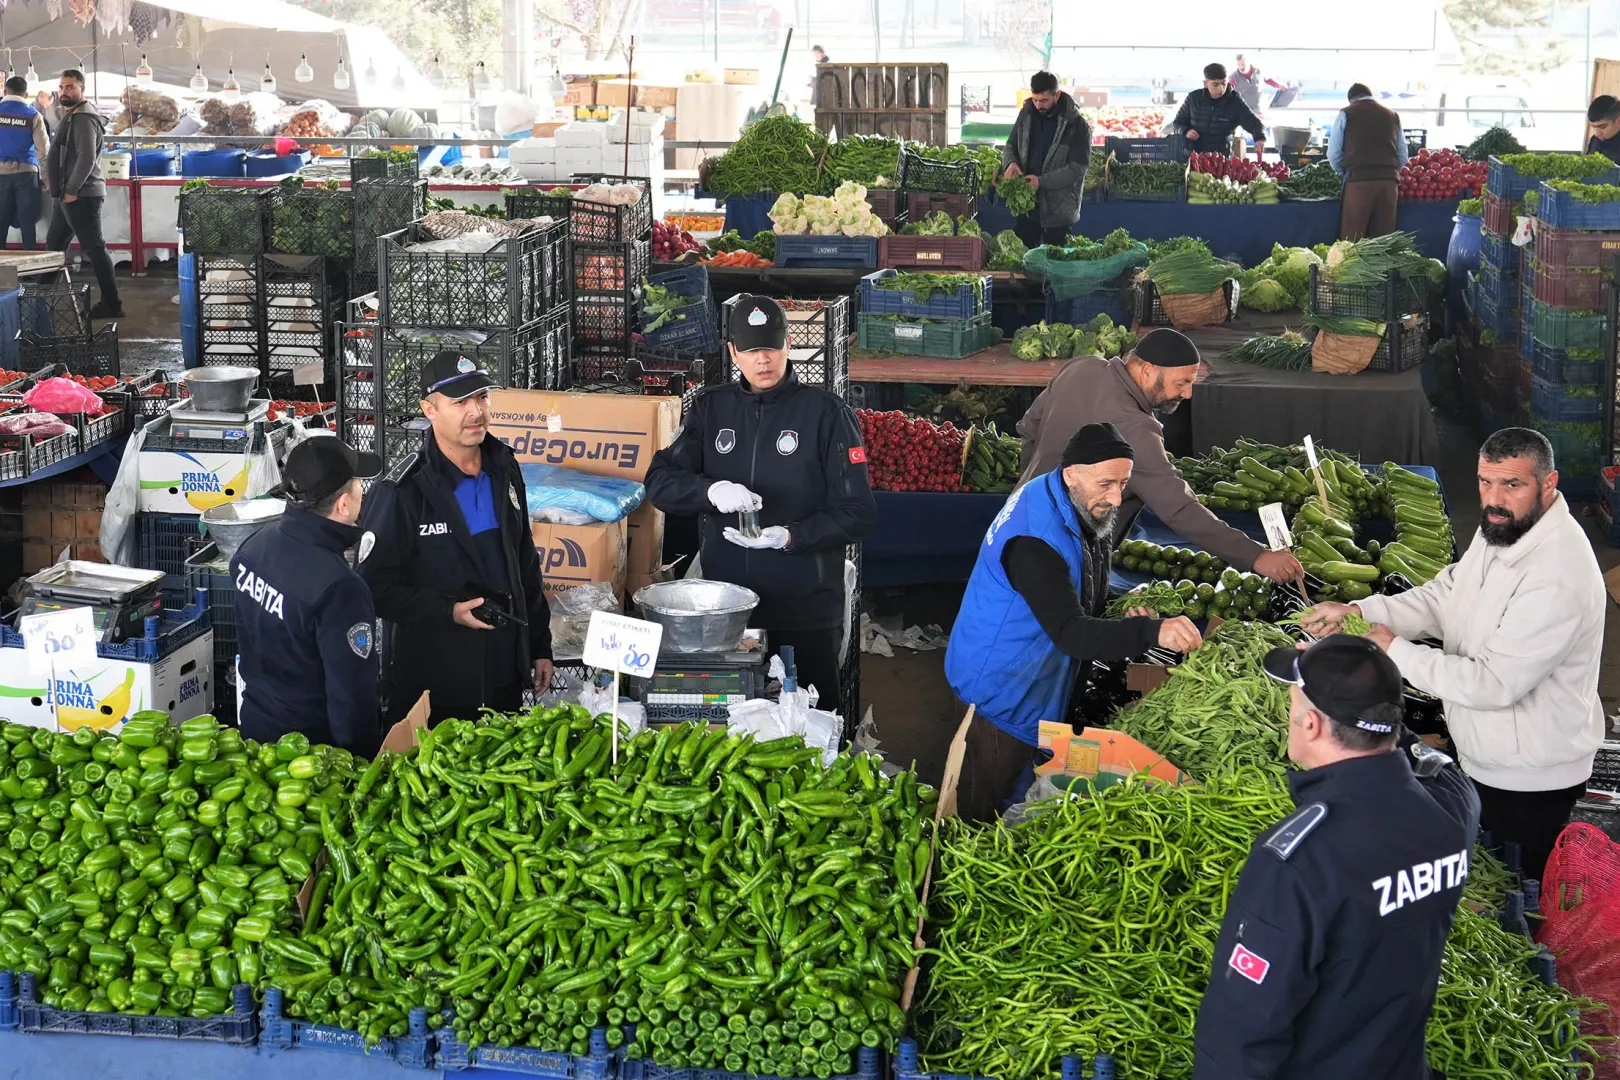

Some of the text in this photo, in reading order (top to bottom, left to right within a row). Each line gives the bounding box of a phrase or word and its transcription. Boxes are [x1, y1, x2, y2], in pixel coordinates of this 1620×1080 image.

[182, 472, 219, 482] PRIMA
[181, 482, 221, 492] DONNA
[419, 522, 452, 536] ZABI
[236, 563, 284, 620] ZABITA
[180, 675, 199, 694] PRIMA
[180, 684, 200, 703] DONNA
[1356, 720, 1392, 733] ZABITA
[1372, 849, 1468, 917] ZABITA
